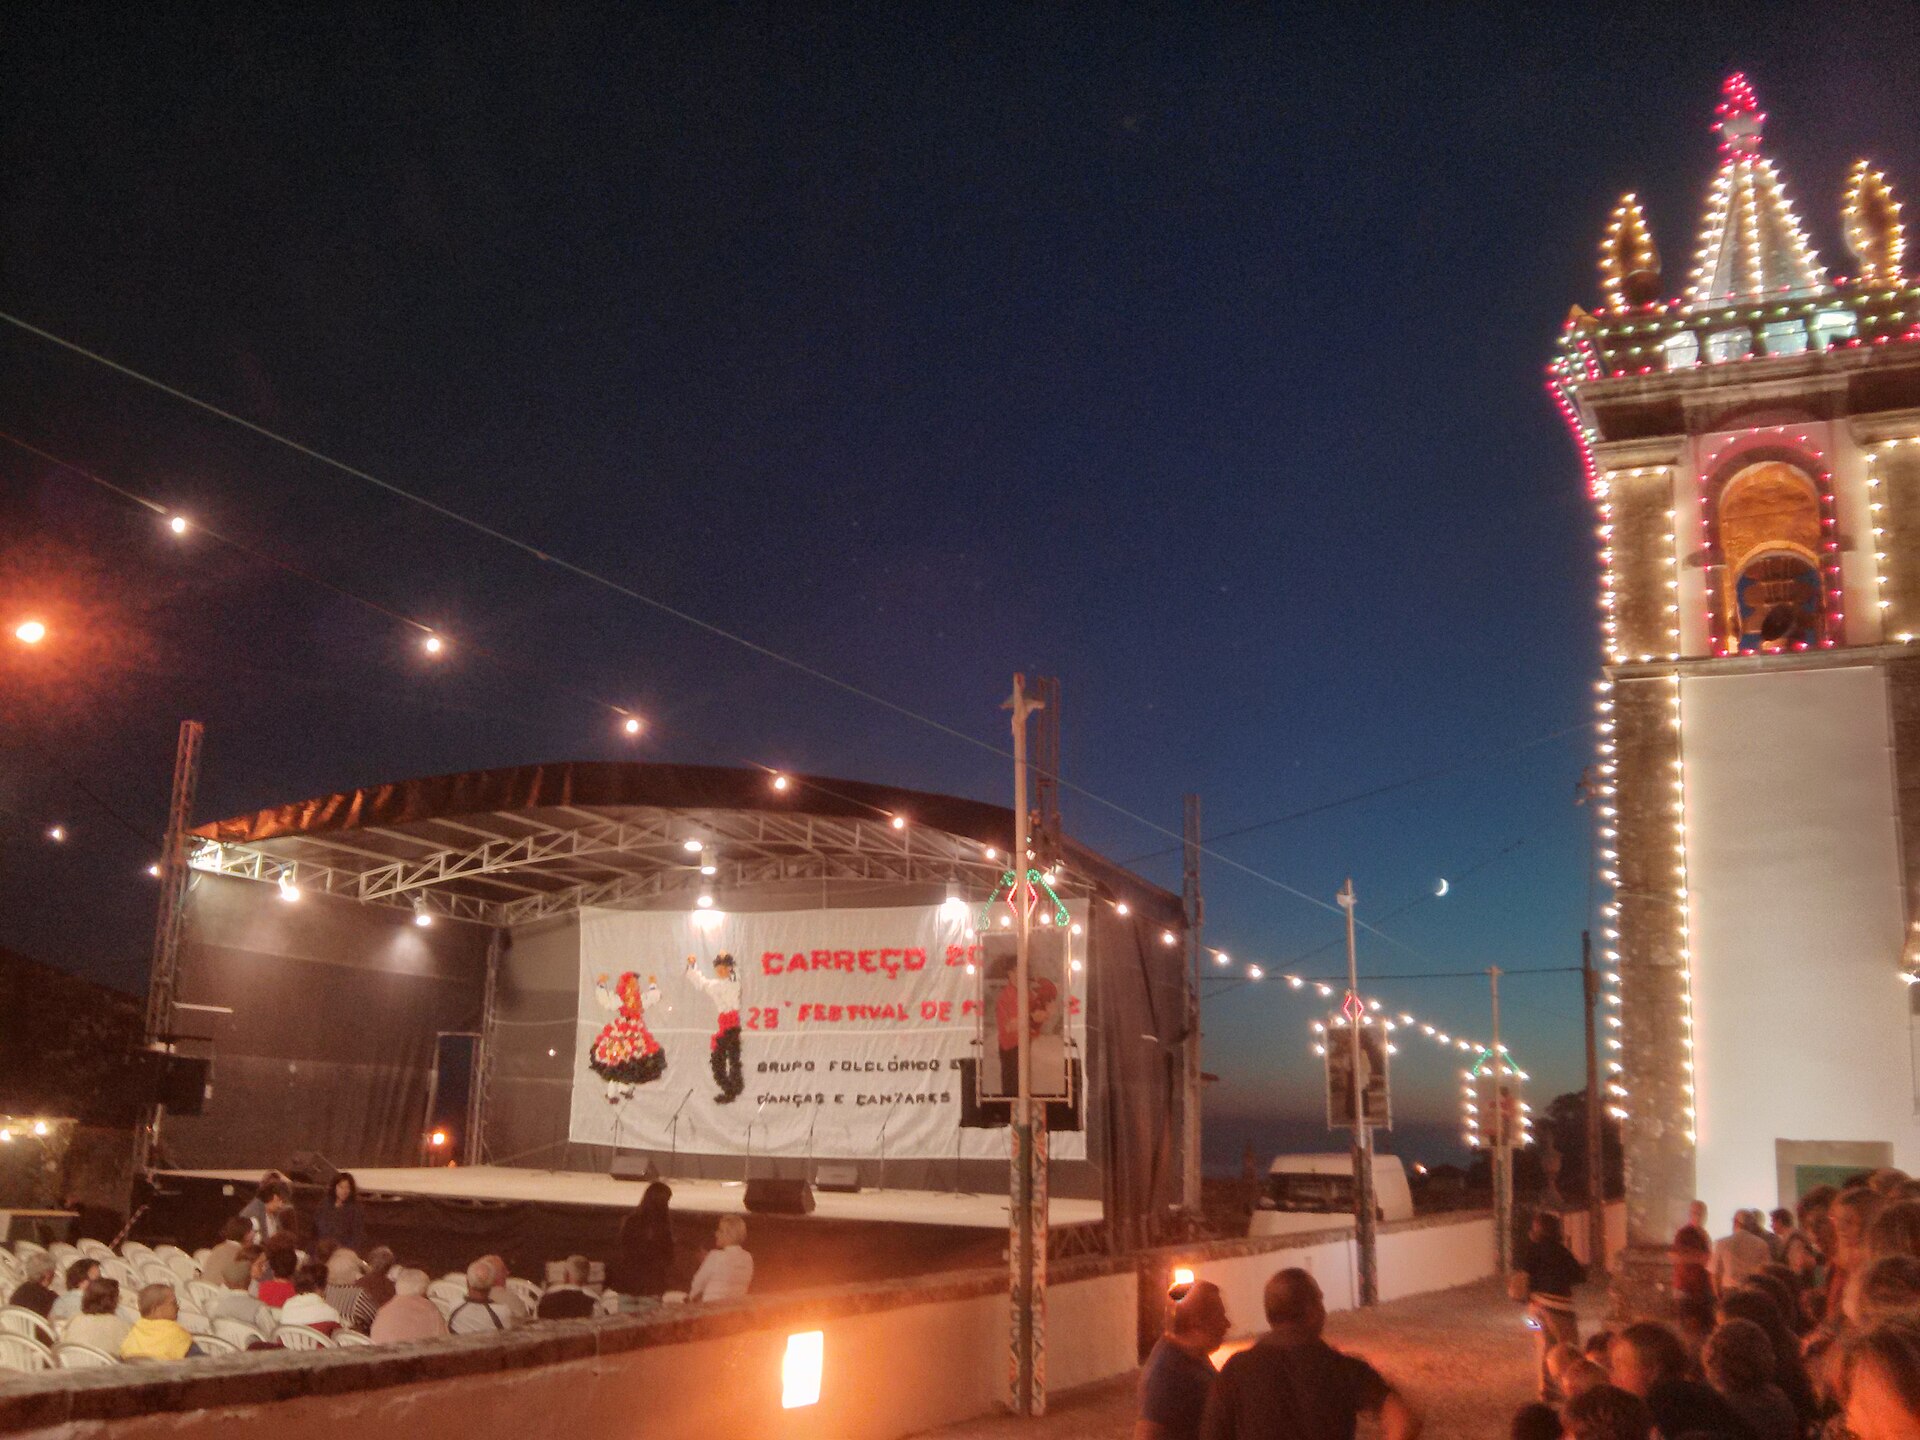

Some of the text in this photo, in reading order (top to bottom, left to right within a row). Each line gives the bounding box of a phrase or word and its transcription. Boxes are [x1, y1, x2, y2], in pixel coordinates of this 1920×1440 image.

[761, 948, 927, 980] CARREÇO
[798, 1003, 909, 1023] FESTIVAL
[920, 1000, 952, 1022] DE
[757, 1060, 815, 1073] GRUPO
[757, 1091, 950, 1108] DANÇAS E CANTARES
